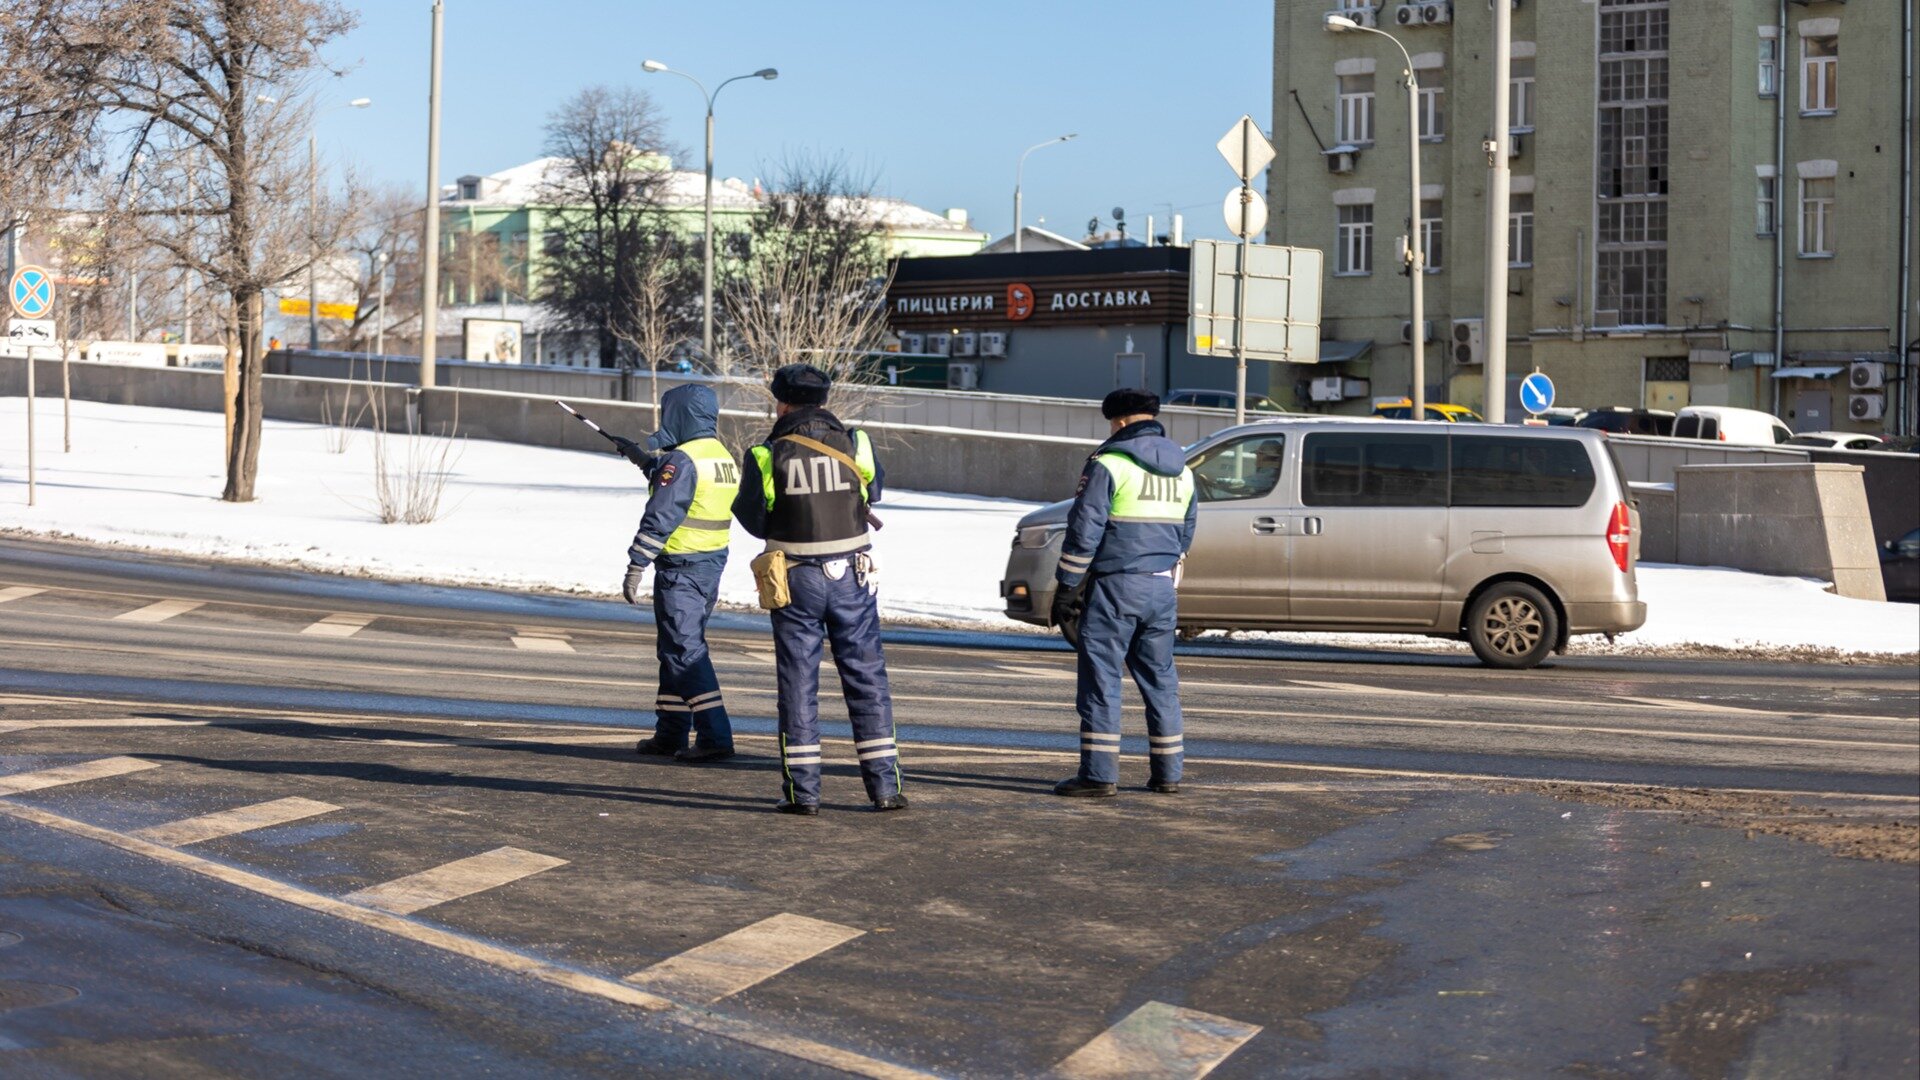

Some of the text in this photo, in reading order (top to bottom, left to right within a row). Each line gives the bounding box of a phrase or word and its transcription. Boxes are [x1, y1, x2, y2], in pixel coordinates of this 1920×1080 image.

[898, 295, 994, 314] ПИЦЦЕРИЯ
[1051, 289, 1151, 311] ДОСТАВКА
[714, 462, 737, 484] ДПС
